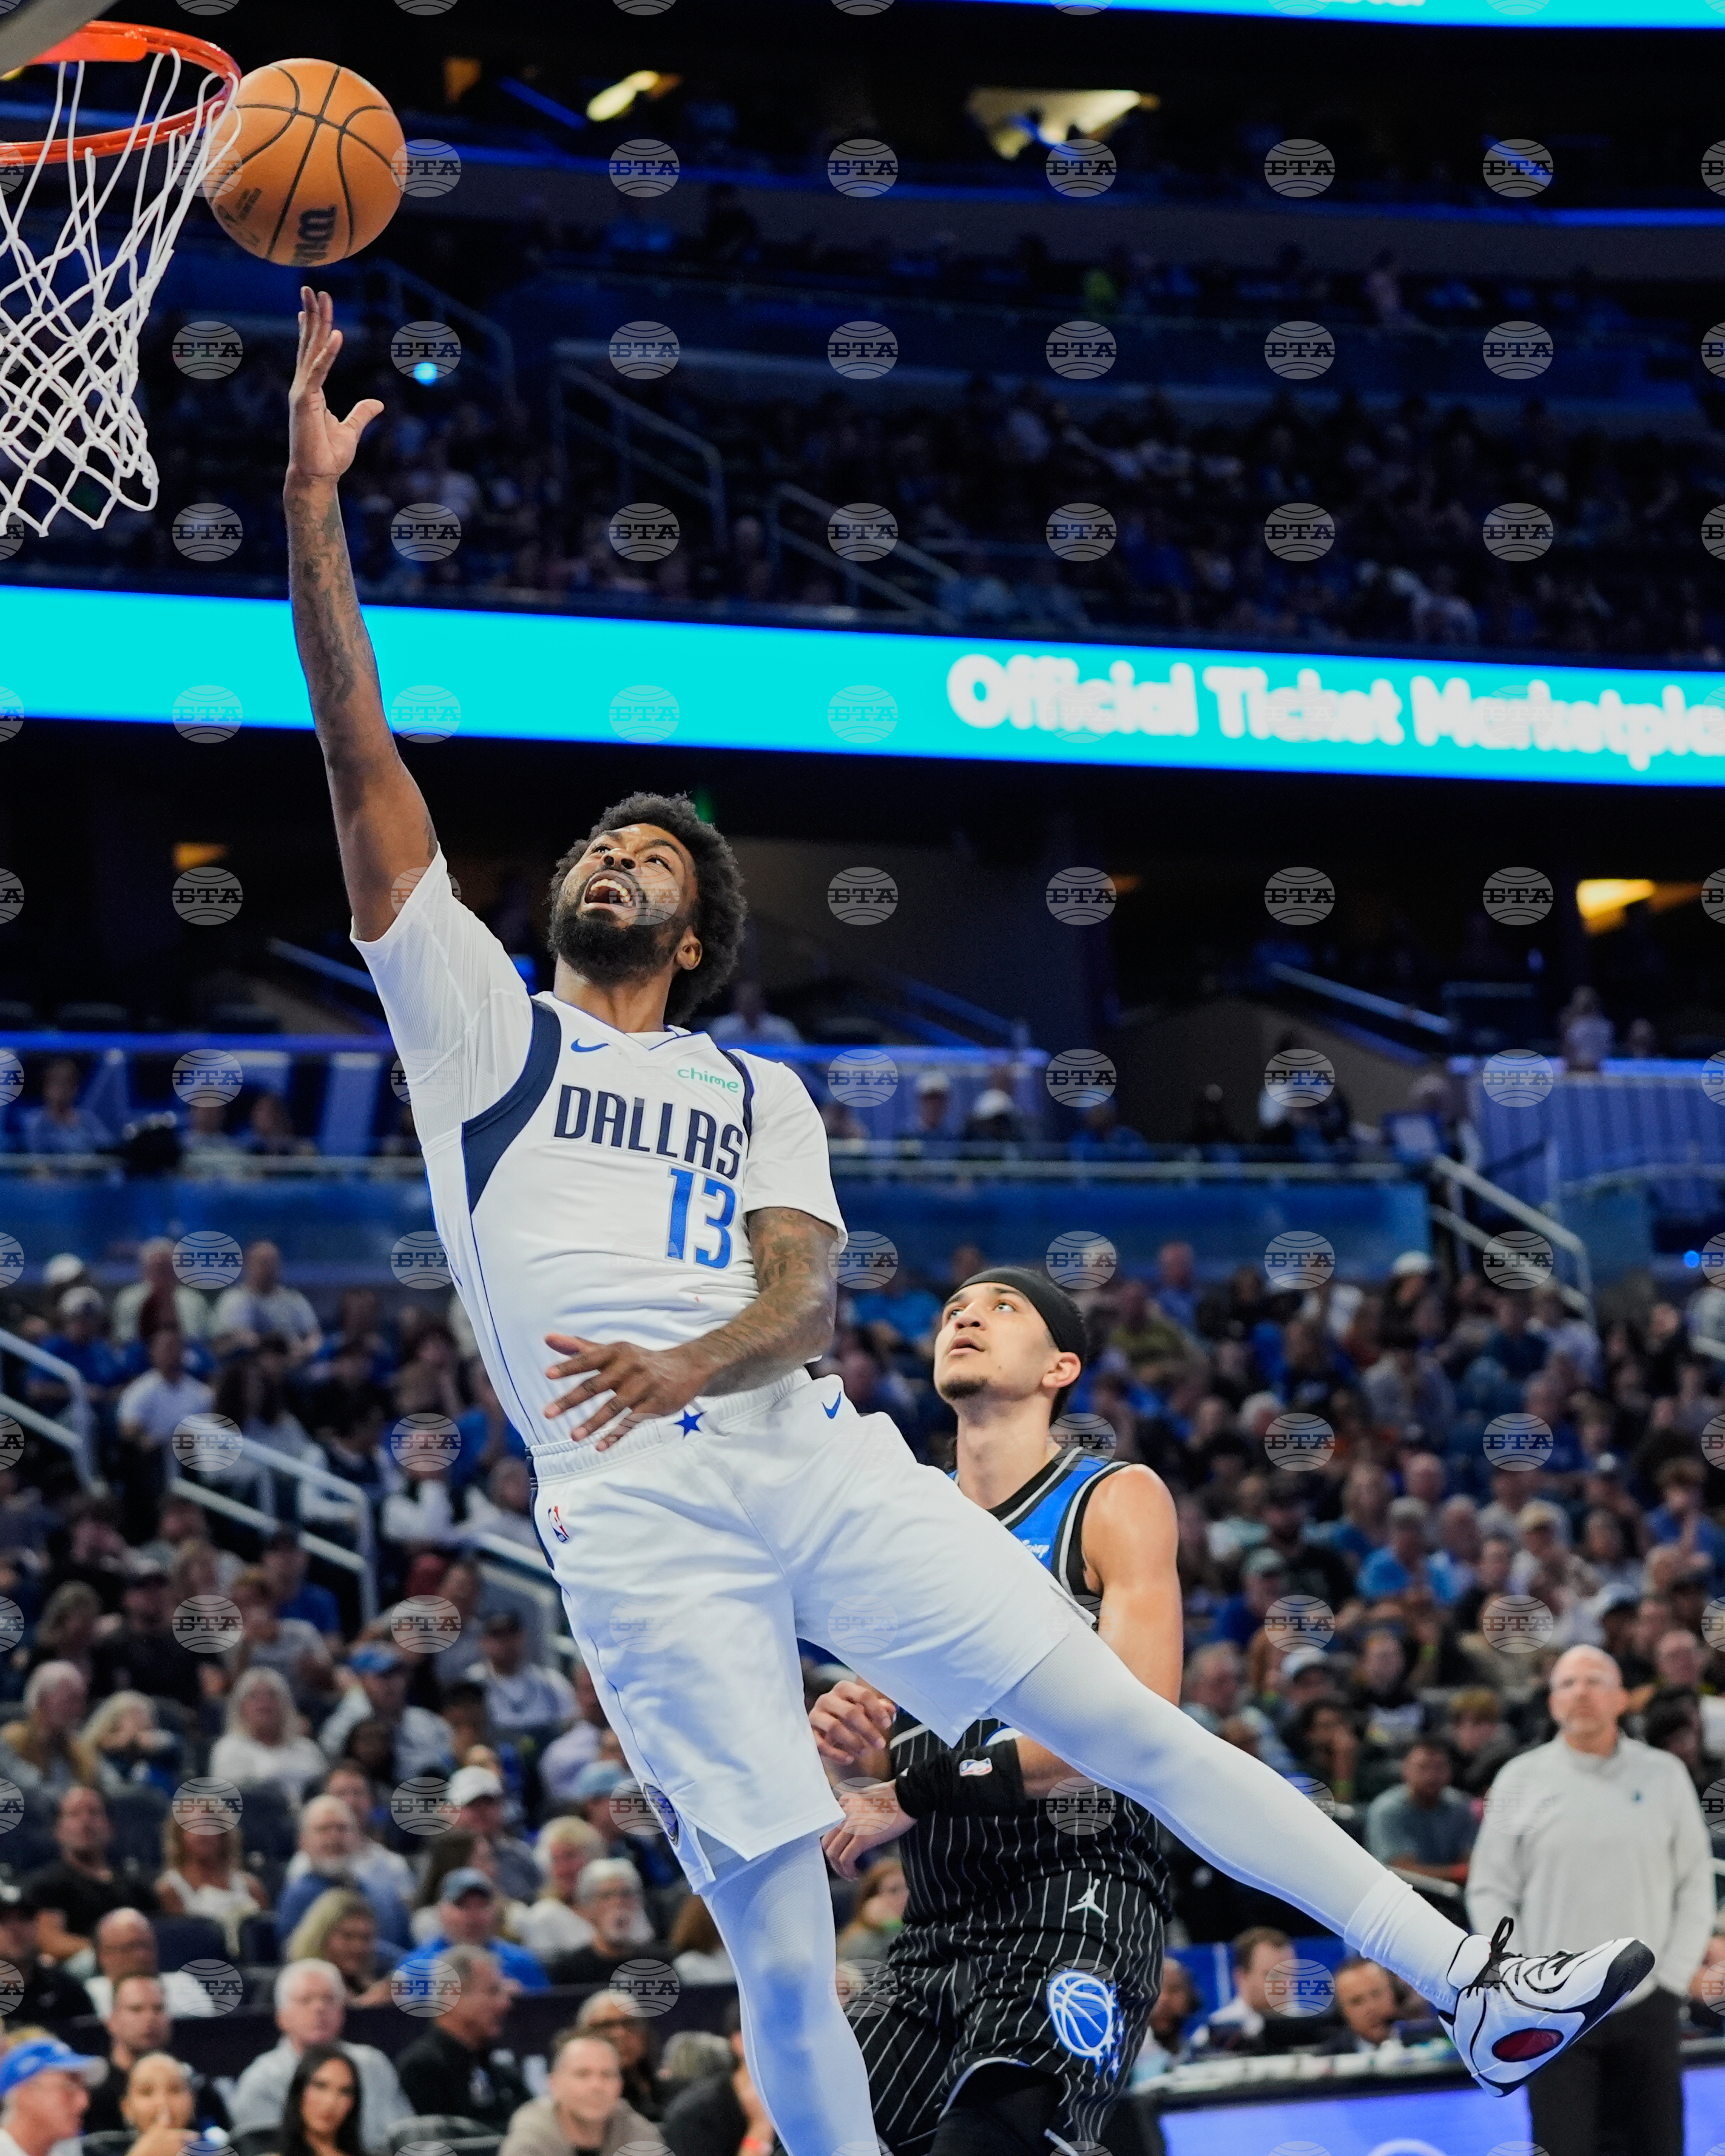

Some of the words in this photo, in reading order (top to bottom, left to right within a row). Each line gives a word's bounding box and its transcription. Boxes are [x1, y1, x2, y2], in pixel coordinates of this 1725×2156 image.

[948, 655, 1198, 736] Official
[1203, 666, 1403, 744] Ticket
[677, 1067, 739, 1093] chime
[553, 1083, 744, 1180] DALLAS
[666, 1167, 737, 1270] 13
